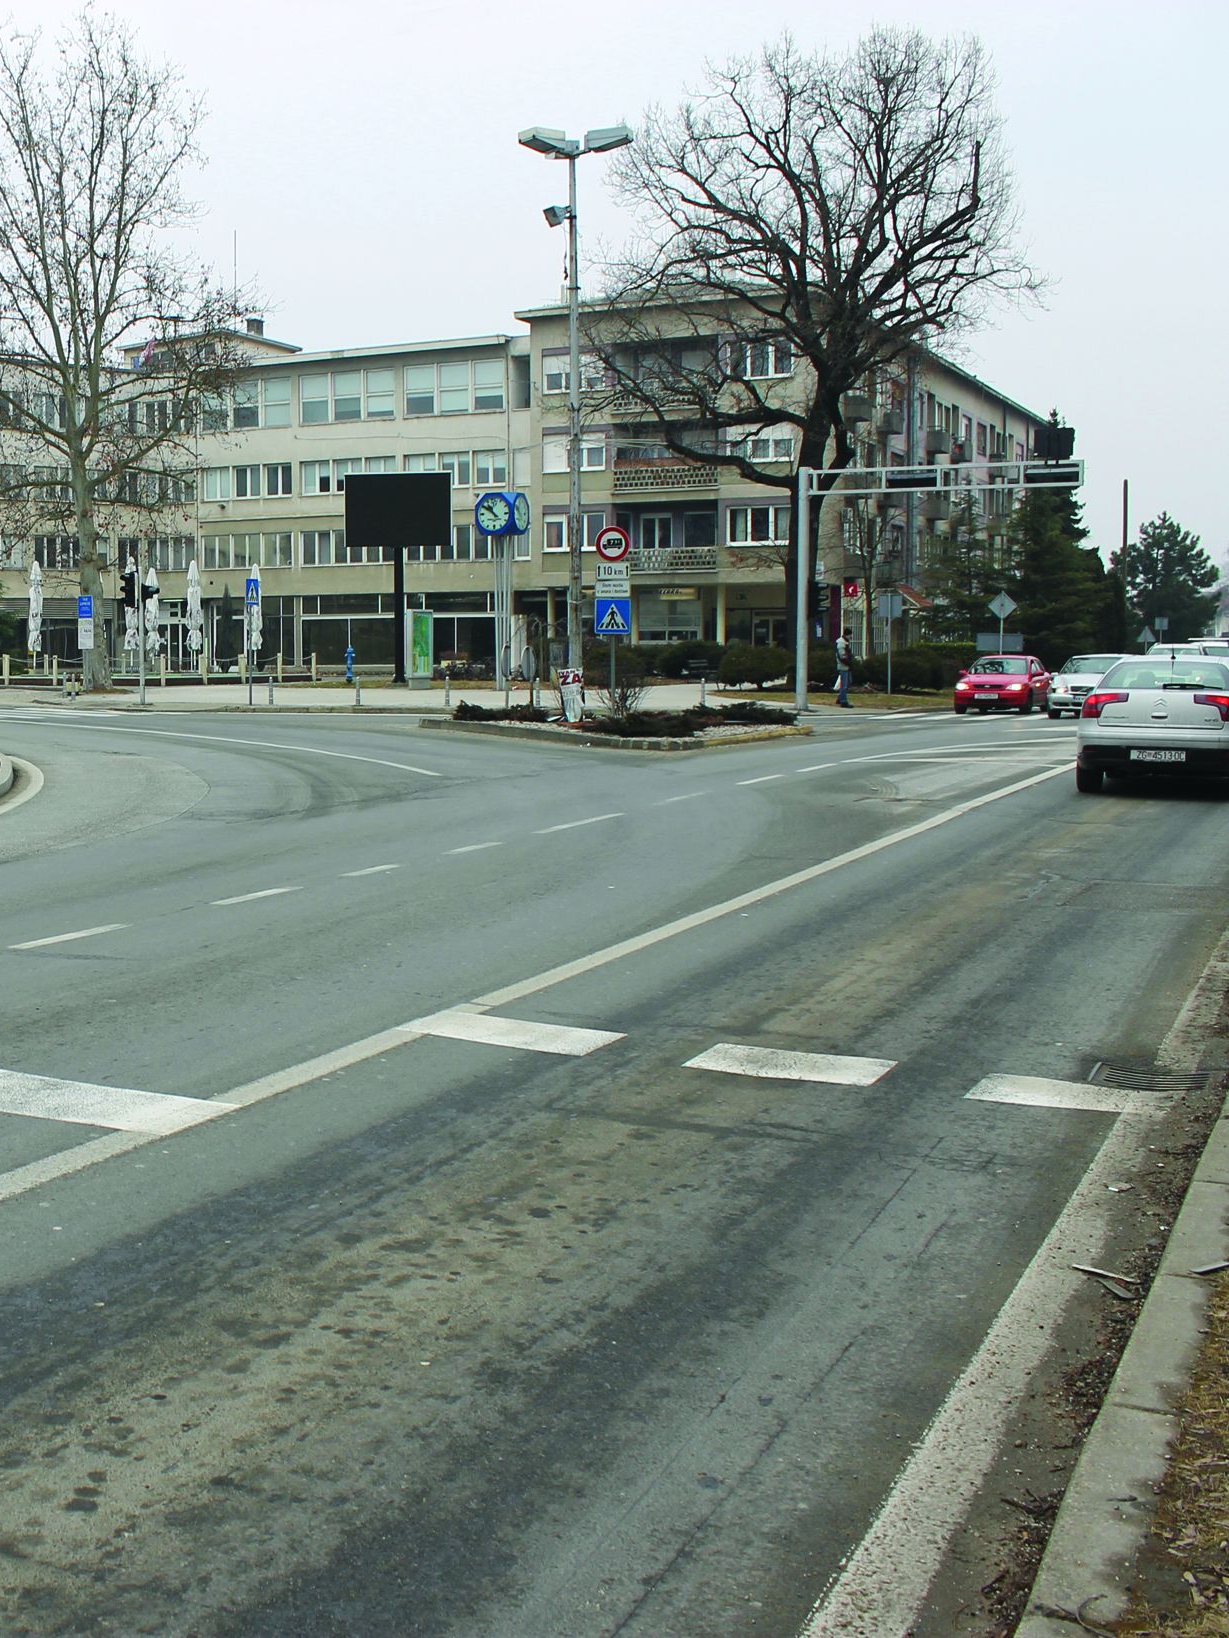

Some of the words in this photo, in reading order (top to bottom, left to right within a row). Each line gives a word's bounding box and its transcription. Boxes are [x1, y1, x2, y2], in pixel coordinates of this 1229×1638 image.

[603, 565, 613, 576] 10
[614, 567, 624, 576] km
[1136, 750, 1147, 760] ZG
